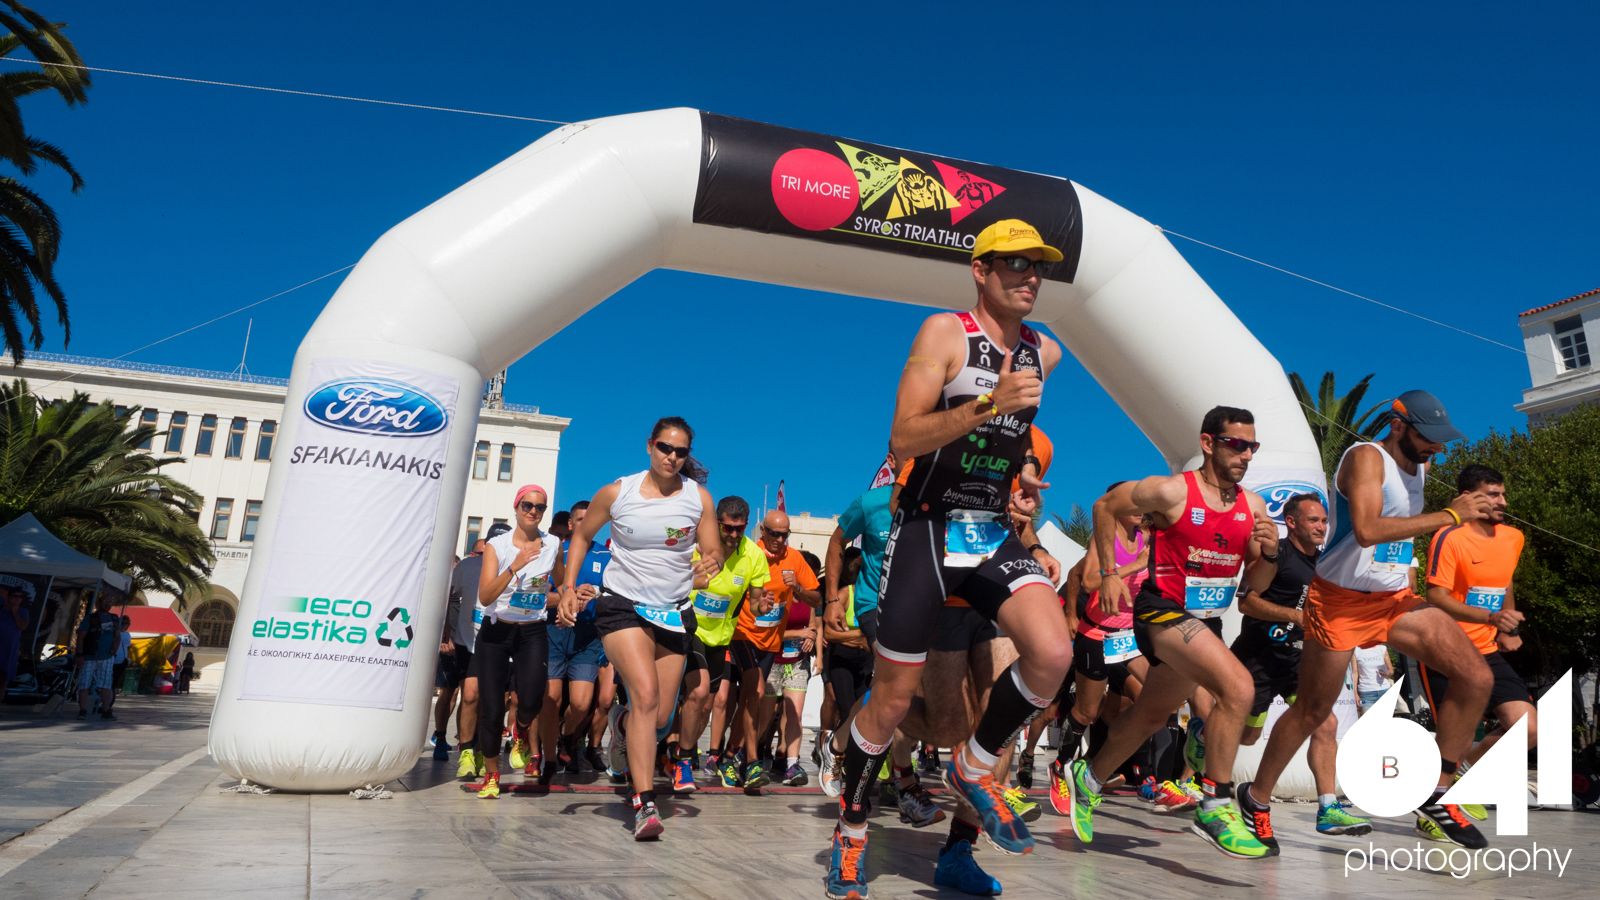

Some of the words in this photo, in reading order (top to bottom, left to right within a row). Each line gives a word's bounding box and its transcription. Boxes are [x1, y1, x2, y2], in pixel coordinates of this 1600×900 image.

[780, 174, 801, 191] TRI
[804, 179, 851, 200] MORE
[854, 216, 901, 237] SYROS
[904, 223, 976, 249] TRIATHLO
[325, 384, 426, 430] Ford
[290, 446, 443, 480] SFAKIANAKIS
[1386, 542, 1404, 556] 531
[520, 593, 539, 604] 515
[703, 598, 721, 609] 543
[1198, 588, 1225, 602] 526
[1477, 594, 1500, 607] 512
[310, 597, 372, 619] eco
[252, 616, 368, 645] elastika
[1113, 636, 1133, 650] 533
[260, 649, 313, 661] ΟΙΚΟΛΟΓΙΚΗΣ
[313, 653, 366, 665] ΔΙΑΧΕΙΡΙΣΗΣ
[367, 657, 409, 668] ΕΛΑΣΤΙΚΩΝ
